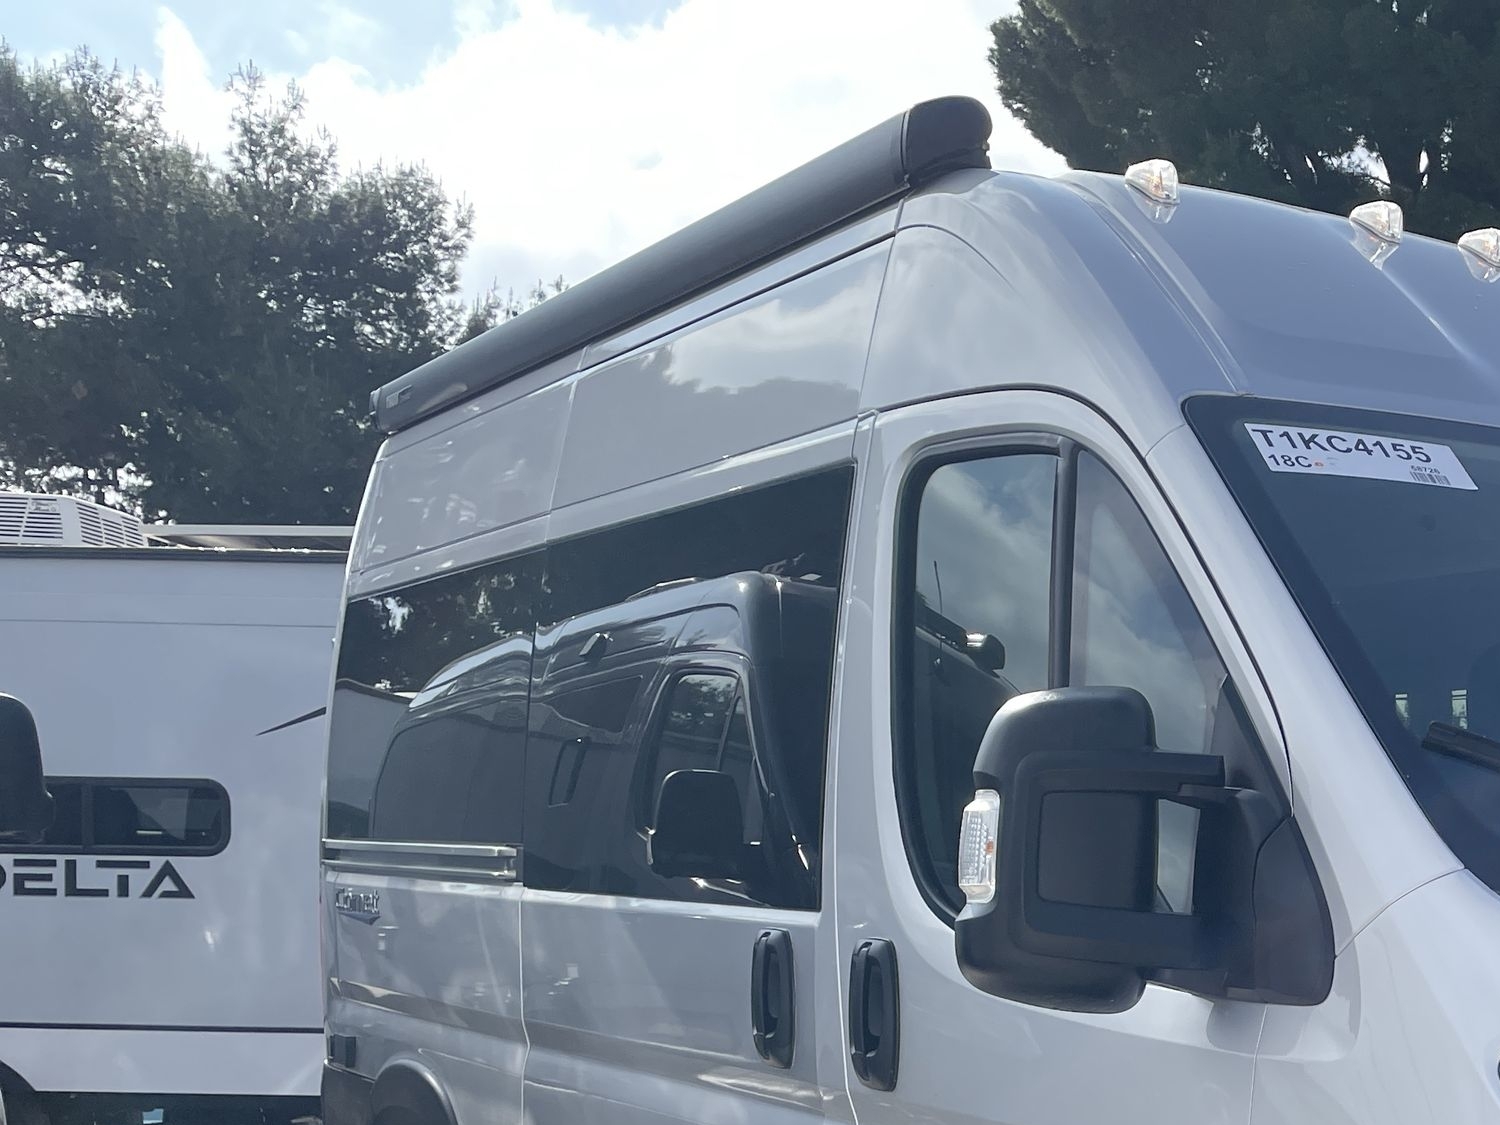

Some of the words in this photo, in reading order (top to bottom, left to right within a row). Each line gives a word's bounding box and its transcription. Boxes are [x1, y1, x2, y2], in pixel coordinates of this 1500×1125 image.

[1251, 428, 1432, 463] T1KC4155
[1268, 454, 1312, 468] 18C
[0, 858, 196, 899] ELTA
